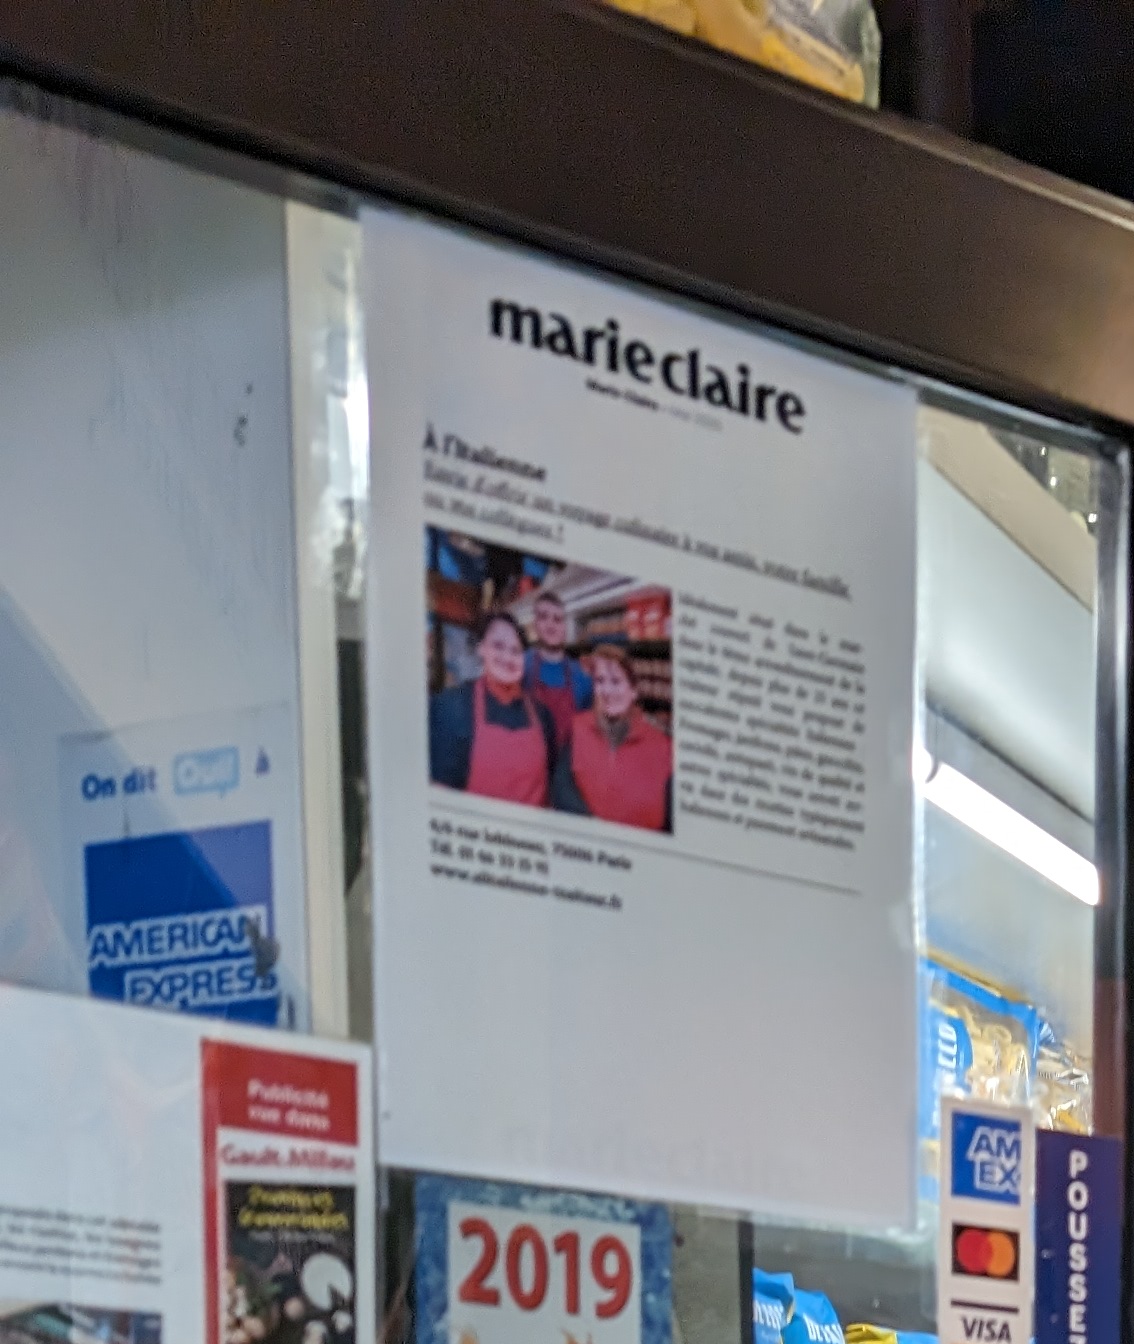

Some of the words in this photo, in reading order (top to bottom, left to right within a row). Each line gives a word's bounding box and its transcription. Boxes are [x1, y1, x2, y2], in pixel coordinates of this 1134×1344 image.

[81, 772, 117, 802] On
[89, 905, 267, 968] AMERICAN
[458, 1216, 634, 1319] 2019
[960, 1315, 1013, 1344] VISA
